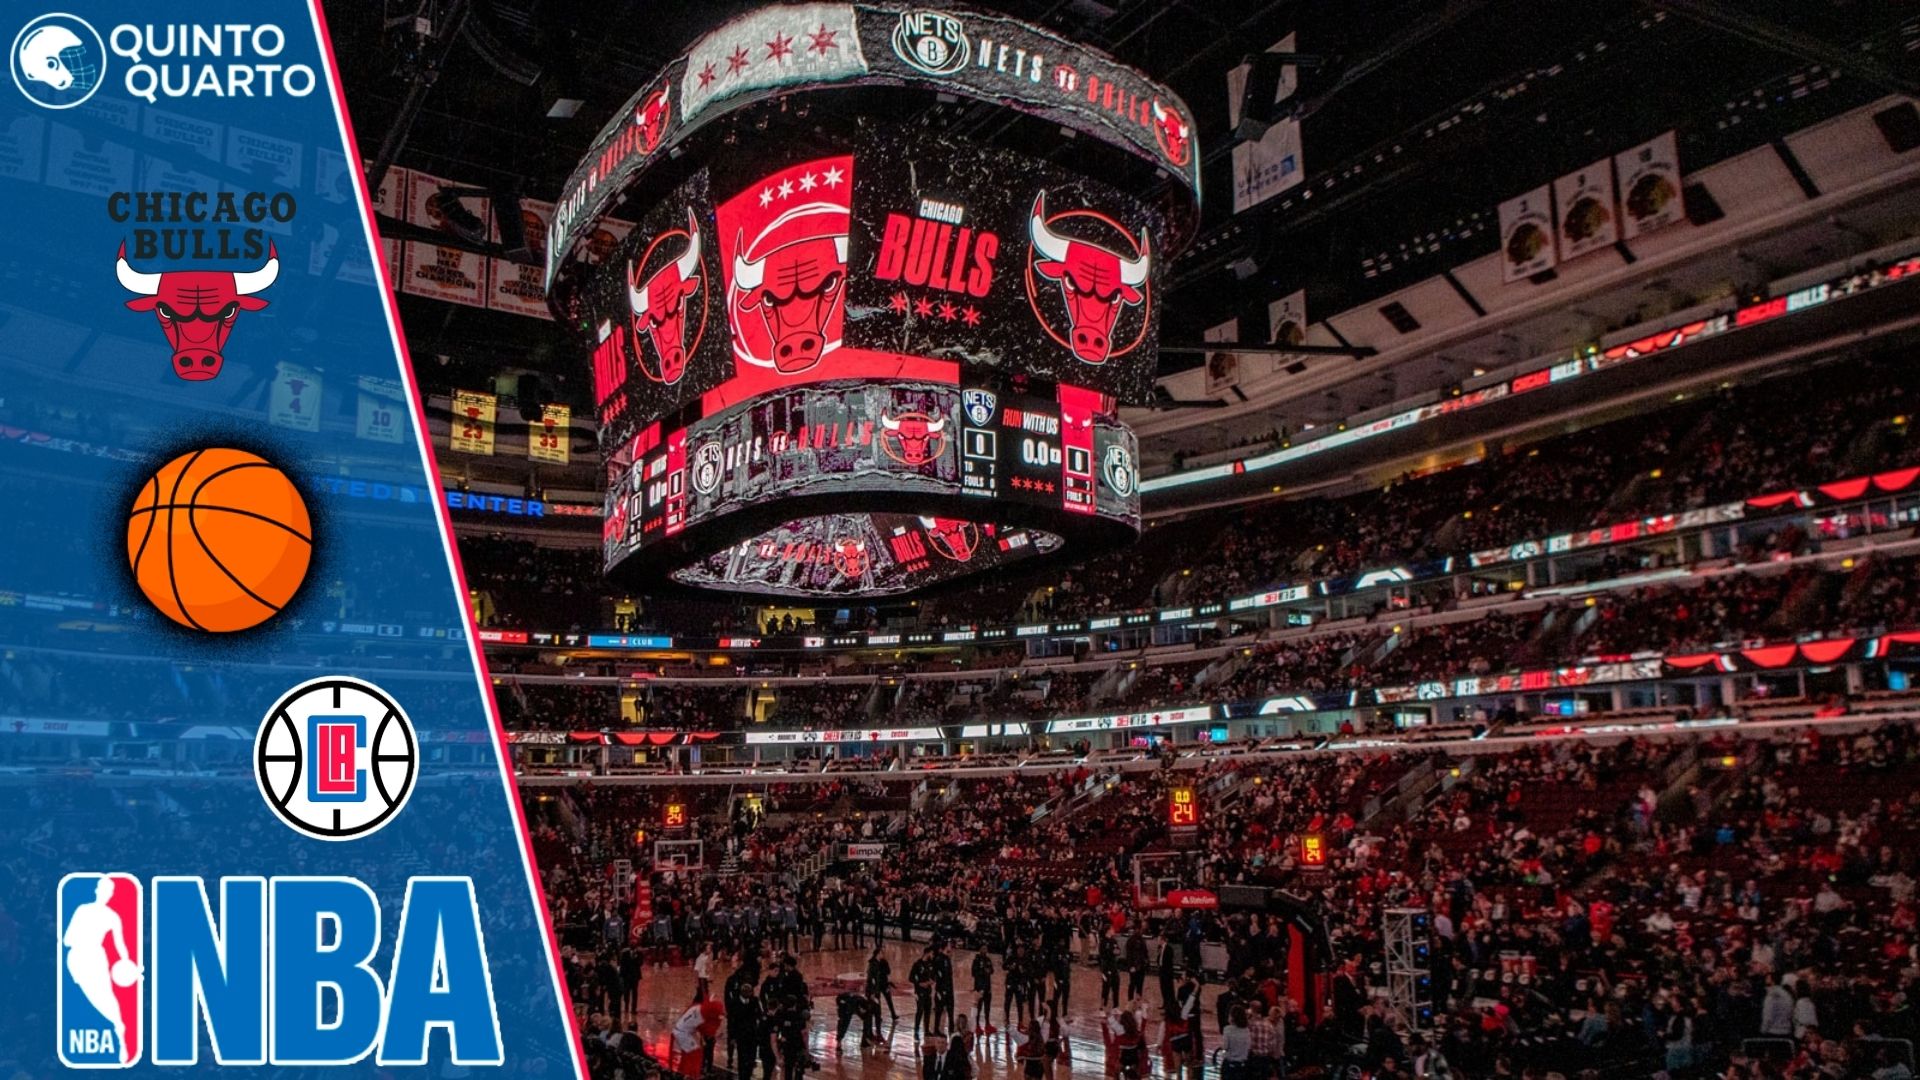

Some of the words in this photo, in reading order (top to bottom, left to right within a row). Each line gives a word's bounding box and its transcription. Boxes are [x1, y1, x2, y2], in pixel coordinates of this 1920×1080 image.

[905, 12, 959, 44] NETS
[977, 37, 1044, 84] NETS
[1087, 75, 1150, 128] BULLS
[919, 199, 965, 225] CHICAGO
[875, 213, 1000, 298] BULLS
[416, 271, 476, 290] CHAMPIONS
[499, 286, 546, 301] CHAMPIO
[965, 390, 994, 409] NETS
[371, 410, 391, 427] 10
[1003, 408, 1022, 428] RUN
[1023, 411, 1045, 433] WITH
[1045, 416, 1059, 435] US
[462, 422, 484, 440] 23
[539, 432, 559, 449] 33
[798, 420, 875, 452] BULLS
[1023, 438, 1049, 467] 0.0
[964, 474, 984, 488] FOULS
[447, 491, 545, 517] ENTER
[666, 812, 683, 825] 24
[1173, 803, 1194, 823] 24
[857, 846, 882, 857] impac
[1306, 848, 1321, 862] 24
